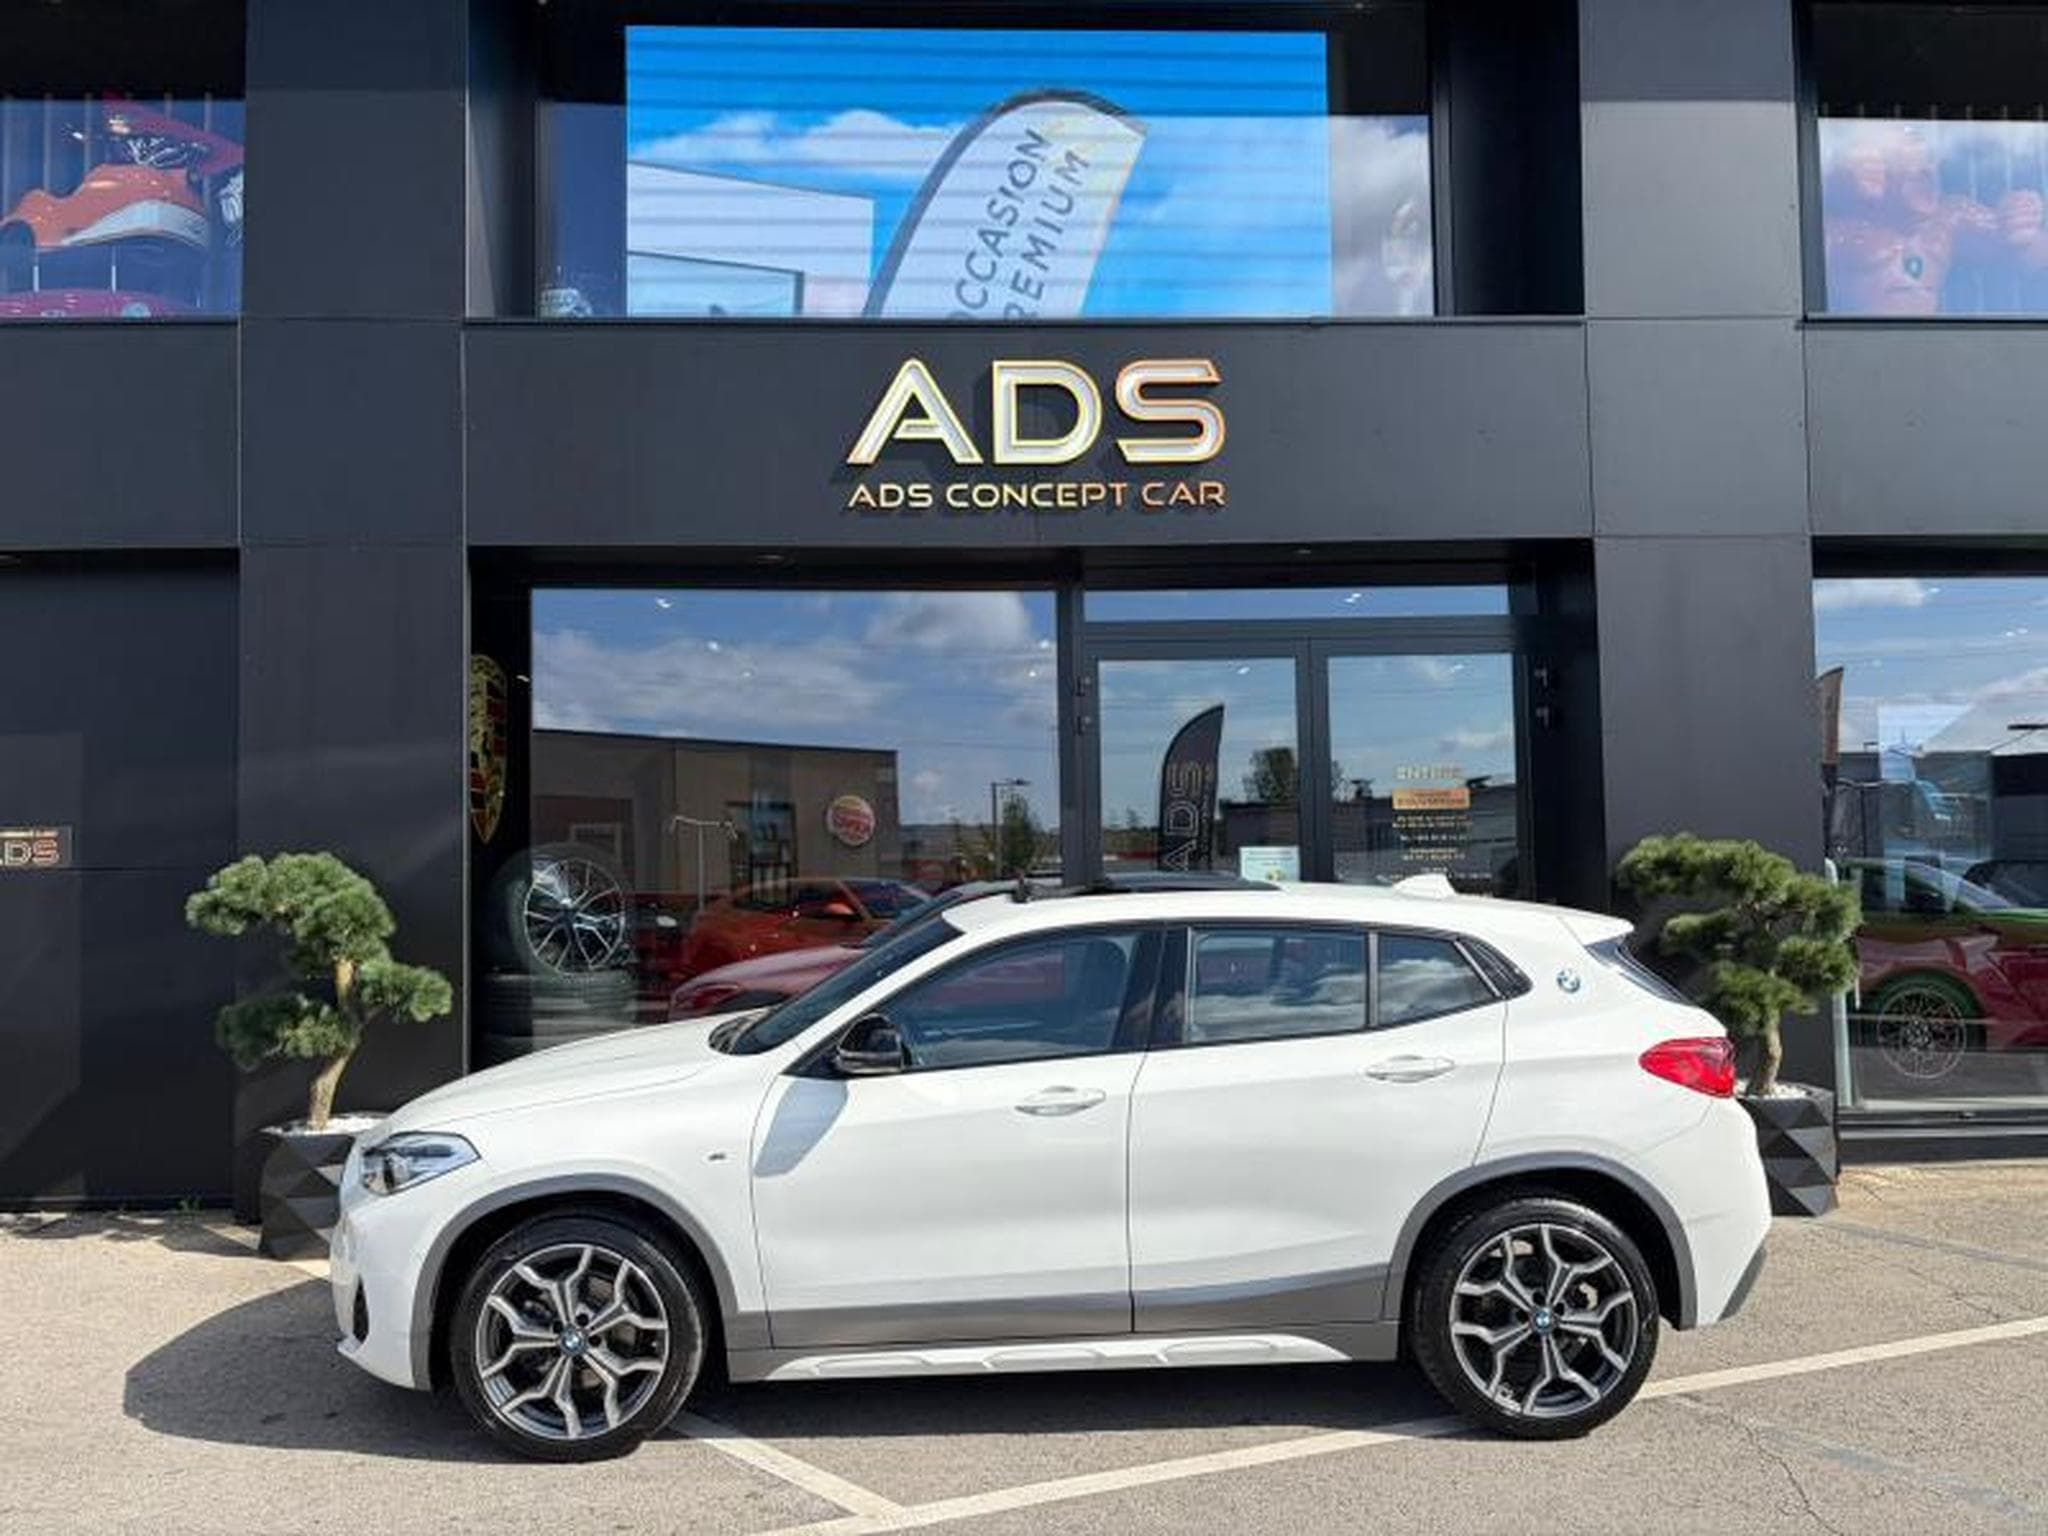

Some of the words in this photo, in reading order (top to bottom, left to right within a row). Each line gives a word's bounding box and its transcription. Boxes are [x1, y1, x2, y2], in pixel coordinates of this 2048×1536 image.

[949, 128, 1053, 319] CCASION
[1003, 151, 1090, 319] REMIUM
[846, 358, 1226, 465] ADS
[847, 483, 932, 508] ADS
[946, 482, 1128, 507] CONCEPT
[1141, 481, 1226, 506] CAR
[0, 840, 59, 866] DS
